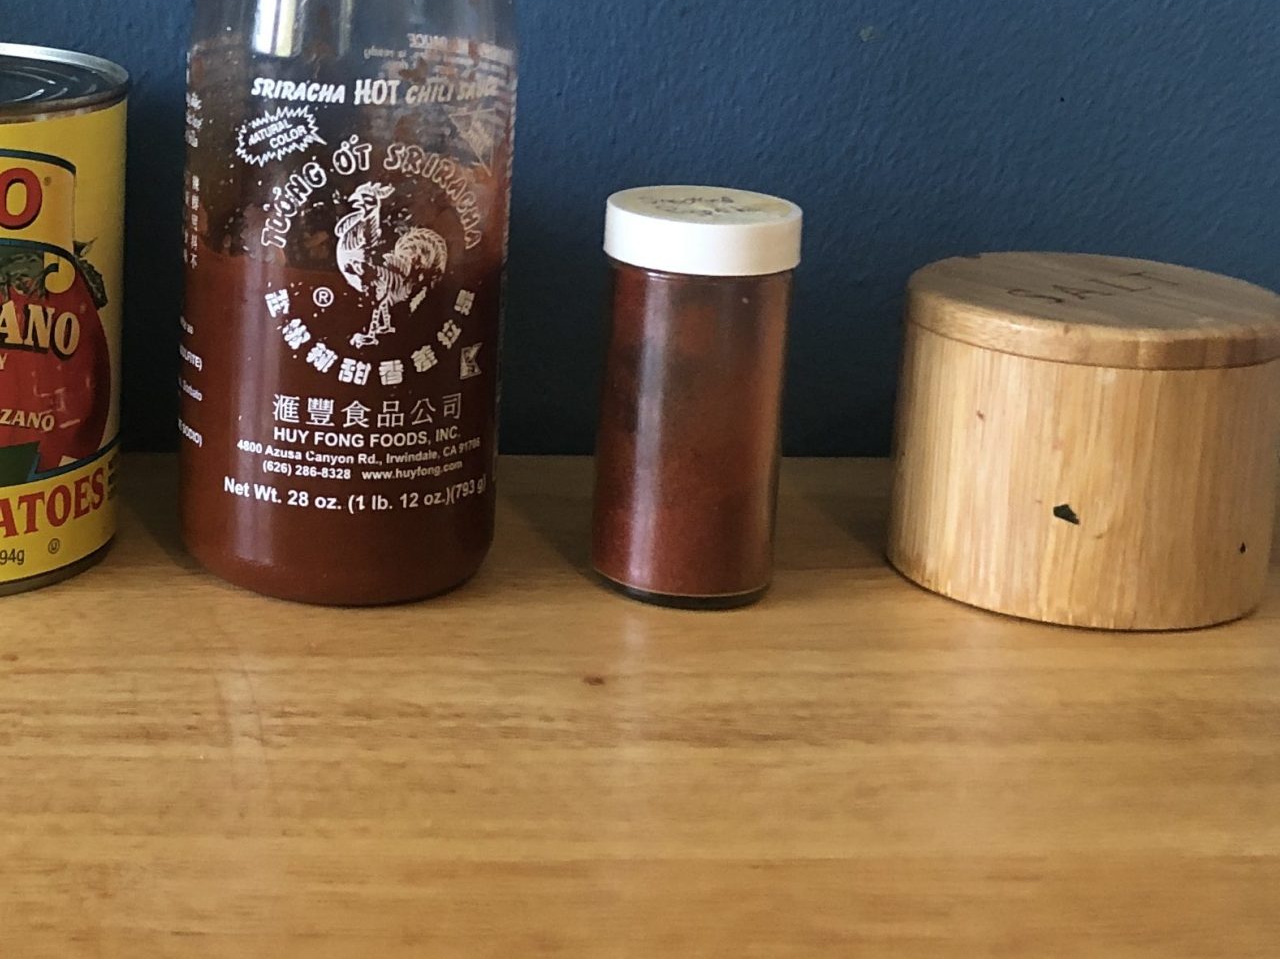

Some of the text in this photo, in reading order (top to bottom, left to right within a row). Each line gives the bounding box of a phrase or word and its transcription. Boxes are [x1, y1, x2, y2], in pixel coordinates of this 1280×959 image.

[251, 77, 346, 103] SRIRACHA
[353, 78, 401, 105] HOT
[404, 84, 454, 103] CHILI
[248, 119, 293, 146] NATURAL
[269, 125, 308, 149] COLOR
[1007, 271, 1180, 304] SALT
[273, 426, 460, 447] HUY FONG FOODS, INC.
[237, 440, 263, 454] 4800
[265, 445, 302, 460] Azusa
[305, 451, 355, 466] Canyon
[443, 445, 457, 457] CA
[262, 460, 463, 479] (626) 286-8328 www.huyfong.com
[224, 476, 250, 498] Net
[254, 483, 282, 504] Wt.
[287, 490, 309, 506] 28
[314, 497, 342, 509] oz.
[348, 494, 366, 515] (1
[371, 495, 393, 510] lb.
[400, 493, 419, 508] 12
